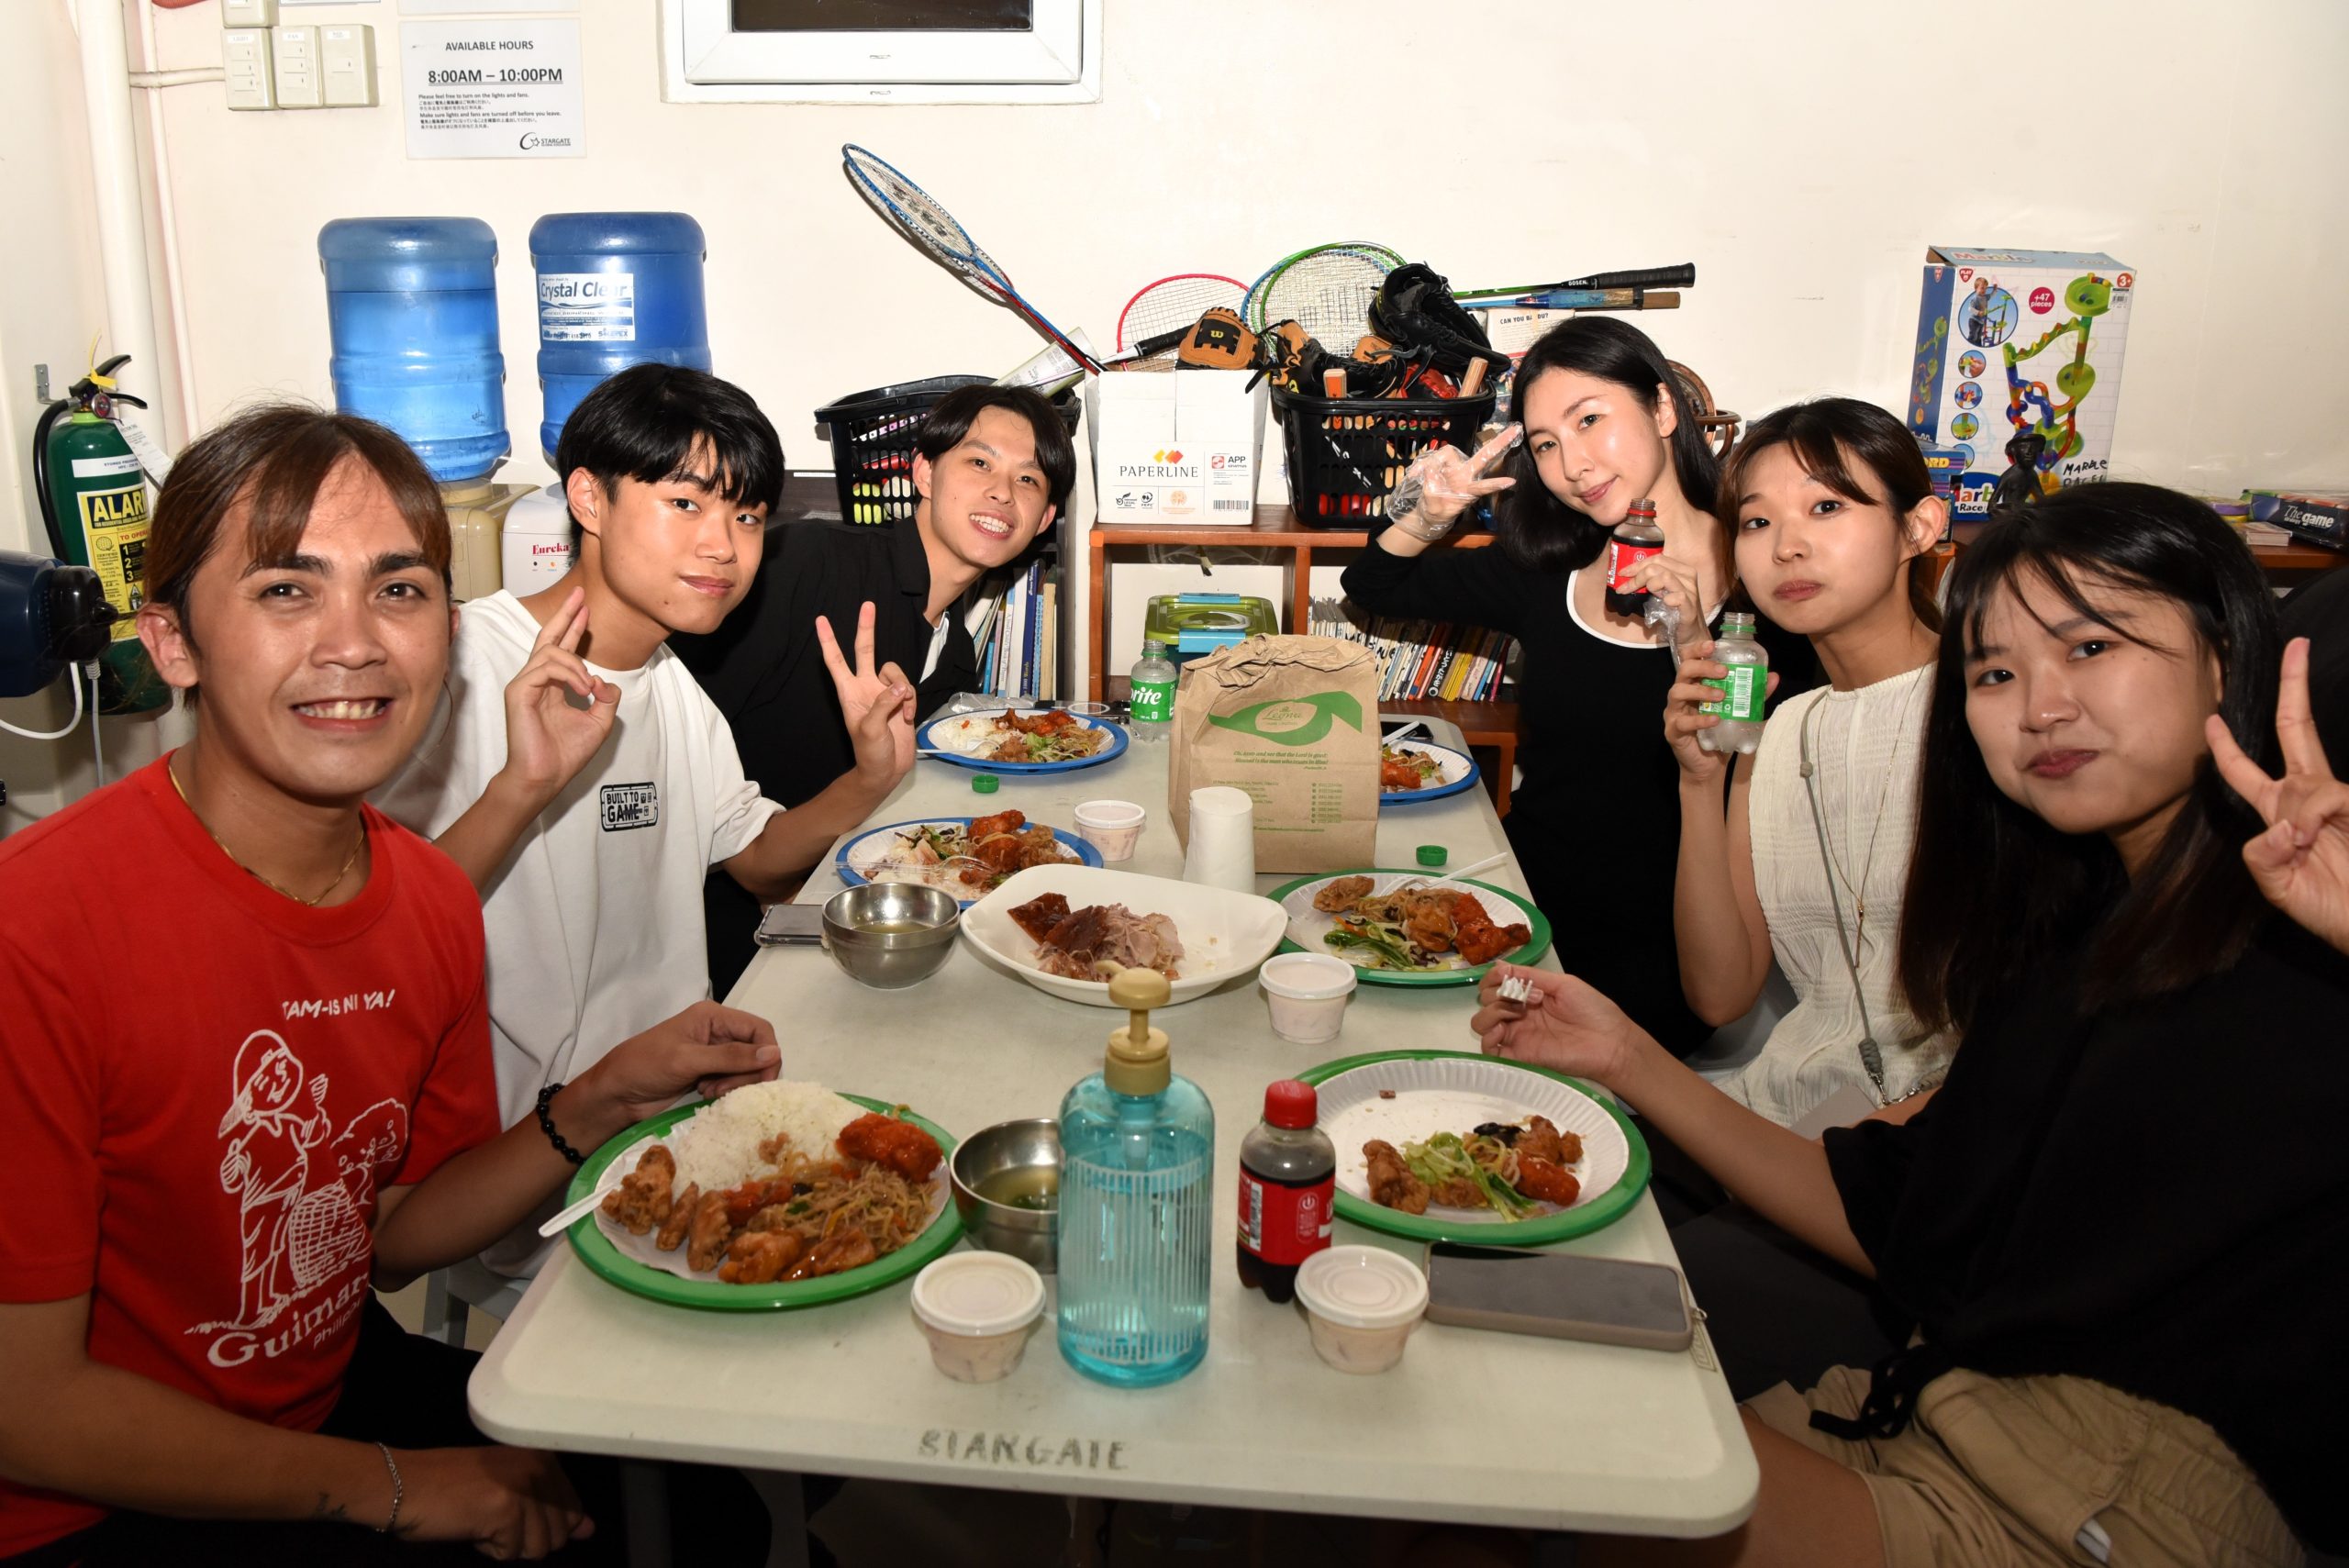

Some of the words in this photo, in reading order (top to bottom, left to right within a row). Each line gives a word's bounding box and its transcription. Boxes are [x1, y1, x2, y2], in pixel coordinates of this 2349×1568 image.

[445, 40, 496, 51] AVAILABLE
[499, 40, 534, 50] HOURS
[429, 69, 483, 83] 8:00AM
[499, 68, 562, 82] 10:00PM
[540, 282, 578, 301] Crystal
[2031, 300, 2053, 308] pieces
[2034, 294, 2050, 302] +47
[1228, 455, 1246, 463] APP
[1119, 465, 1199, 478] PAPERLINE
[1959, 504, 1984, 512] Race
[2284, 505, 2304, 519] The
[2301, 513, 2335, 528] game
[122, 545, 129, 556] 1
[532, 542, 570, 555] Eureka
[124, 557, 133, 569] 2
[126, 570, 134, 582] 3
[607, 792, 628, 805] BUILT
[629, 792, 640, 803] TO
[607, 803, 640, 823] GAME
[282, 998, 340, 1020] TAM-IS
[343, 994, 359, 1014] NI
[363, 988, 396, 1010] YA!
